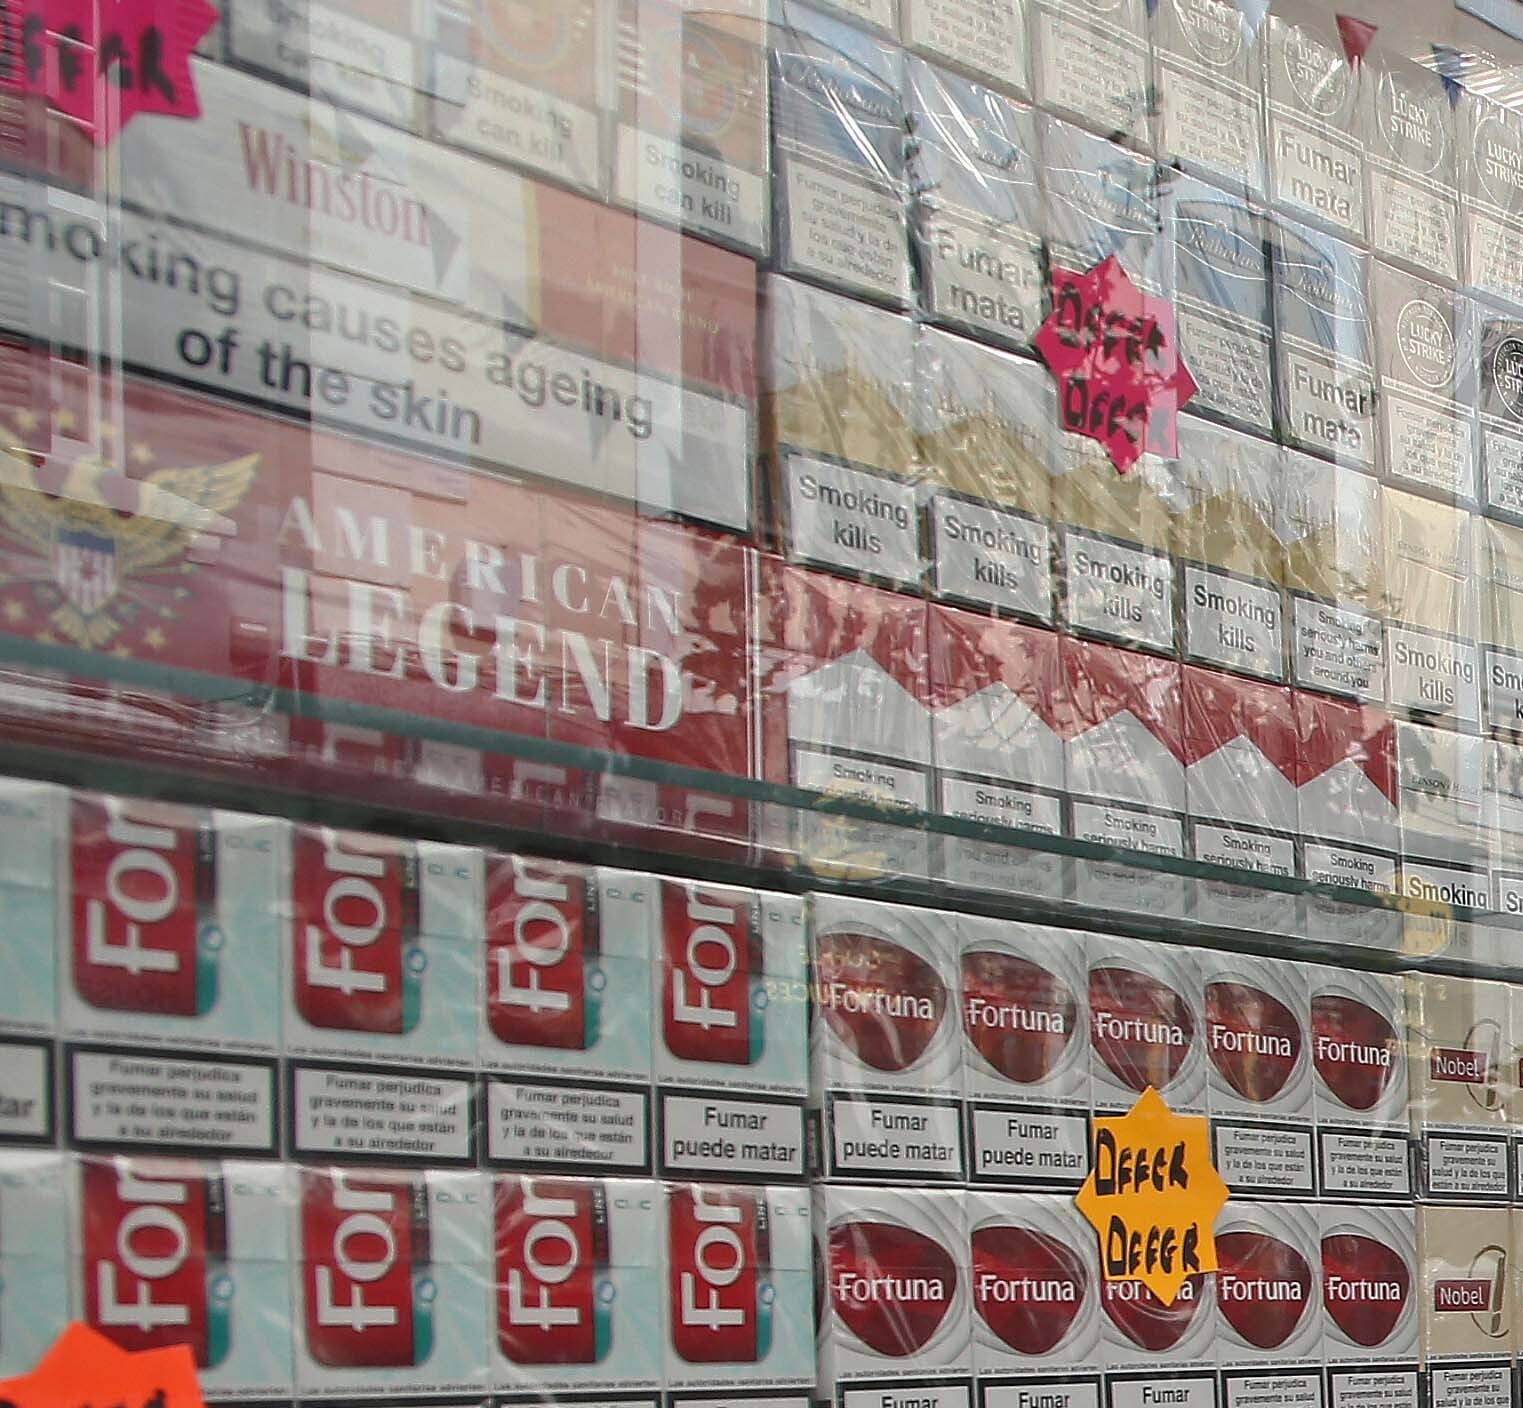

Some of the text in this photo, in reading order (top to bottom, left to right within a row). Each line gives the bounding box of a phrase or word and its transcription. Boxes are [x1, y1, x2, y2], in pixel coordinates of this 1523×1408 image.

[237, 119, 432, 250] Winston
[0, 203, 654, 439] moking causes ageing
[177, 326, 483, 446] of the skin
[798, 472, 909, 531] Smoking
[275, 497, 684, 638] AMERICAN
[833, 520, 884, 557] kills
[279, 565, 686, 733] LEGEND
[971, 1000, 1064, 1035] Fortuna
[704, 1107, 767, 1130] Fumar
[673, 1137, 796, 1164] puede matar
[1094, 1127, 1189, 1196] OFFER
[1106, 1217, 1200, 1276] OFFER
[839, 1273, 944, 1301] Fortuna
